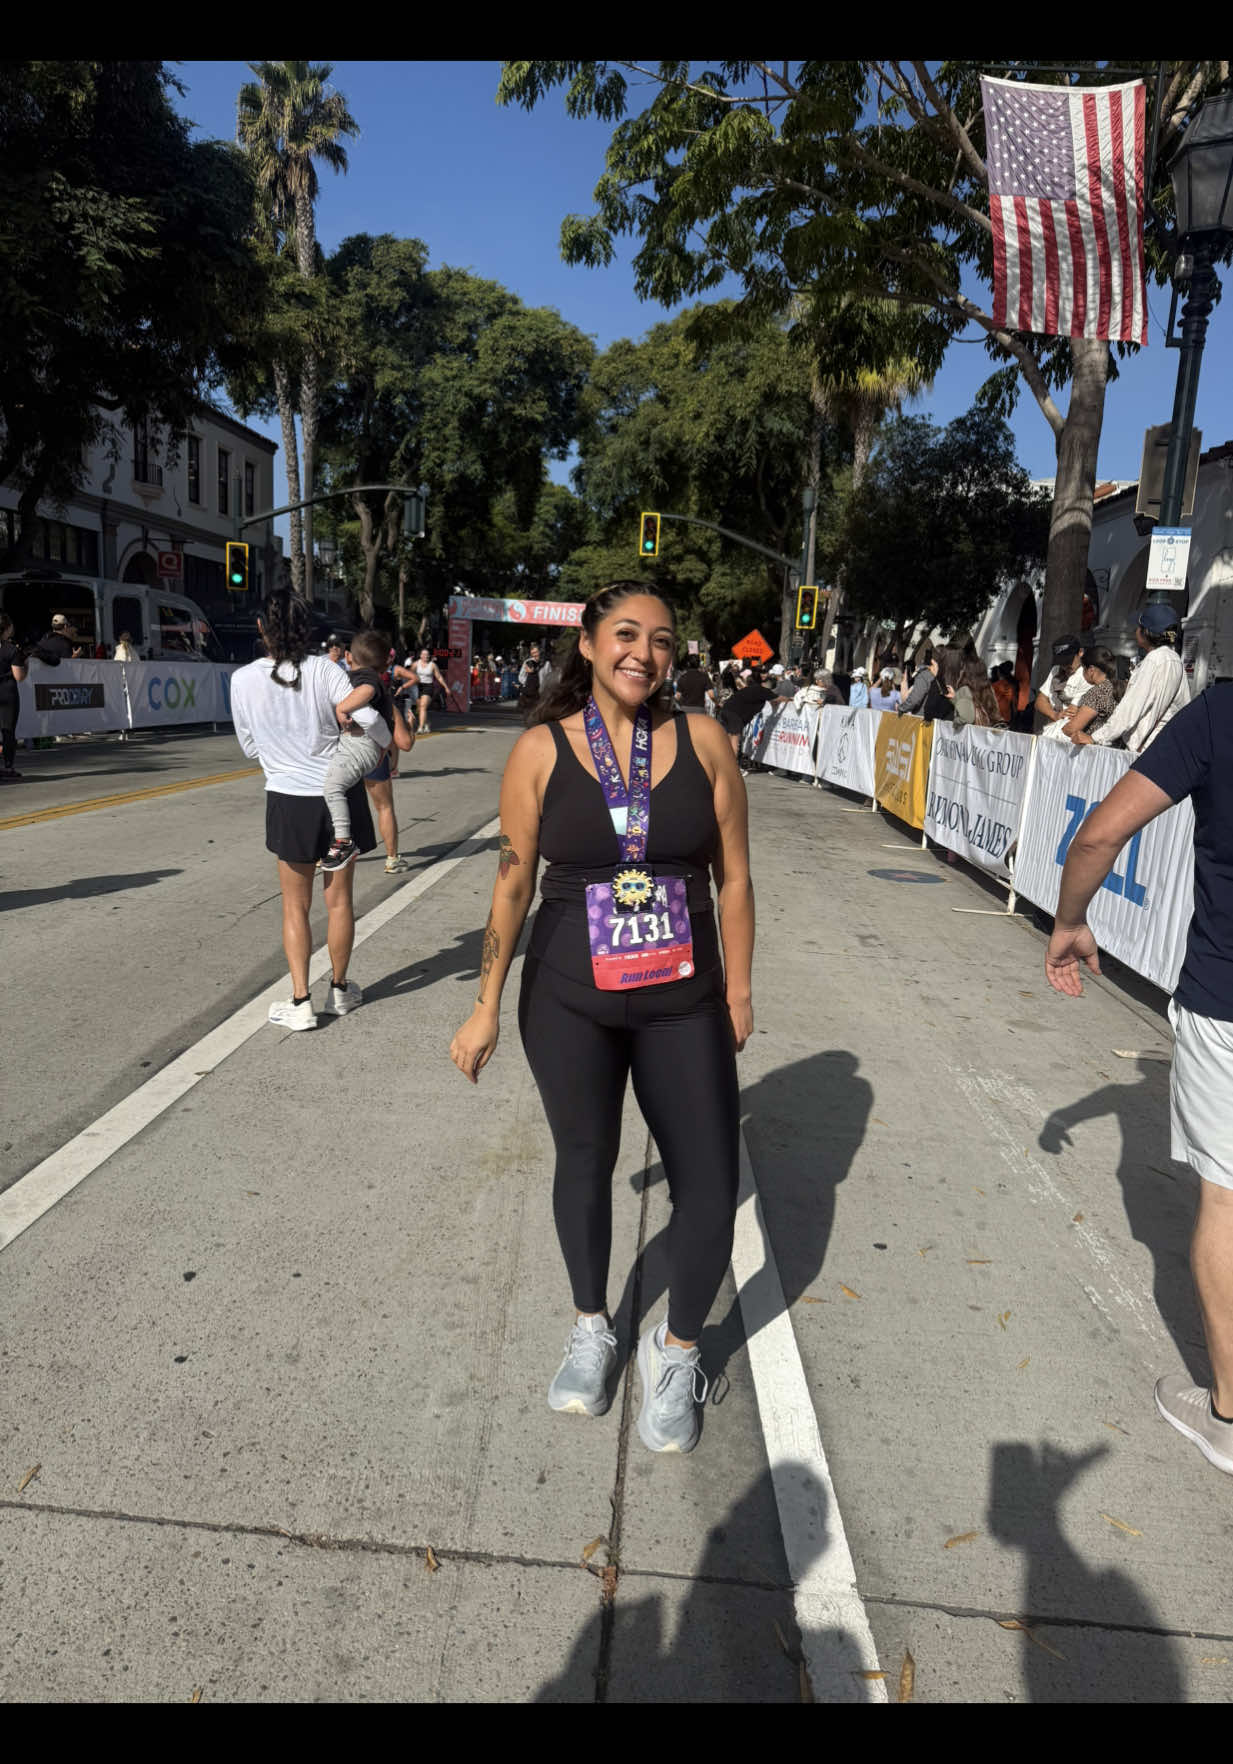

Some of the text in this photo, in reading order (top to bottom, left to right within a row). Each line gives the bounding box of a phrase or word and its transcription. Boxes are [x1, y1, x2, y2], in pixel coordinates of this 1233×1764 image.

[533, 605, 585, 624] FINIS
[147, 676, 196, 711] COX
[986, 750, 1025, 779] GROUP
[967, 813, 1013, 859] JAMES
[609, 912, 674, 946] 7131
